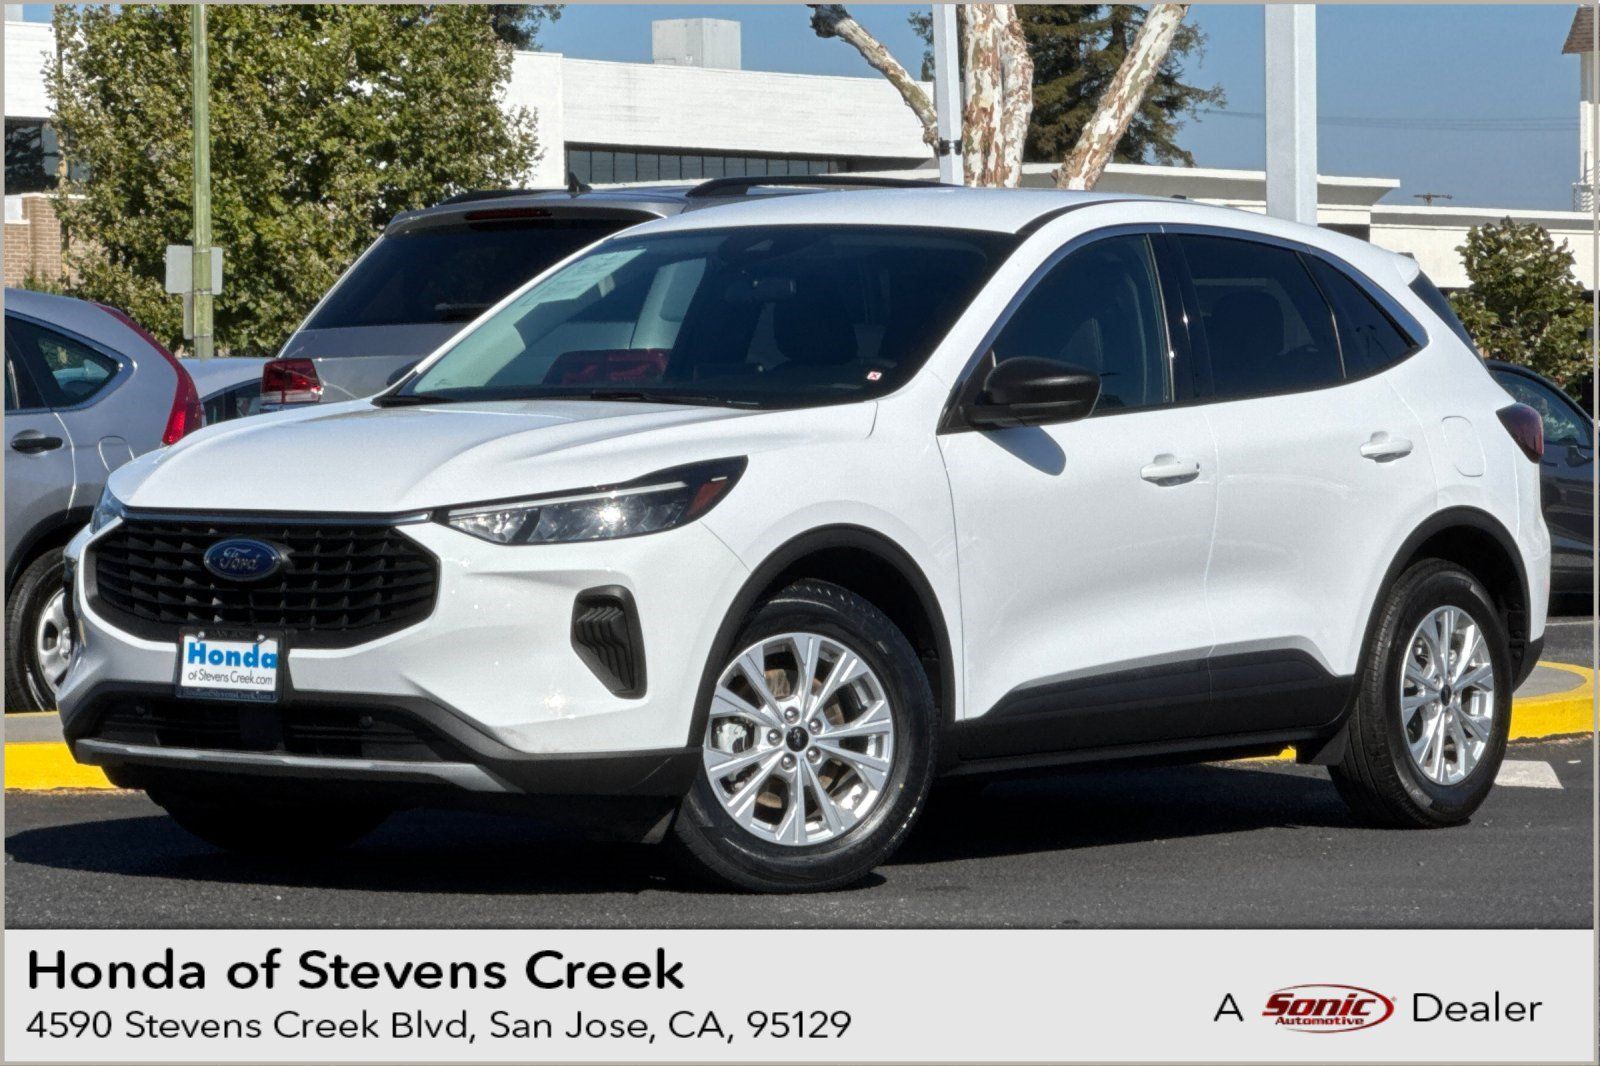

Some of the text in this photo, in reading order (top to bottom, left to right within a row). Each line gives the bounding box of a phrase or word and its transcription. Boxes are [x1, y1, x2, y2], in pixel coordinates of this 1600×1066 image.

[220, 547, 261, 570] Ford
[188, 642, 277, 669] Honda
[188, 669, 273, 685] of Stevens Creek.com
